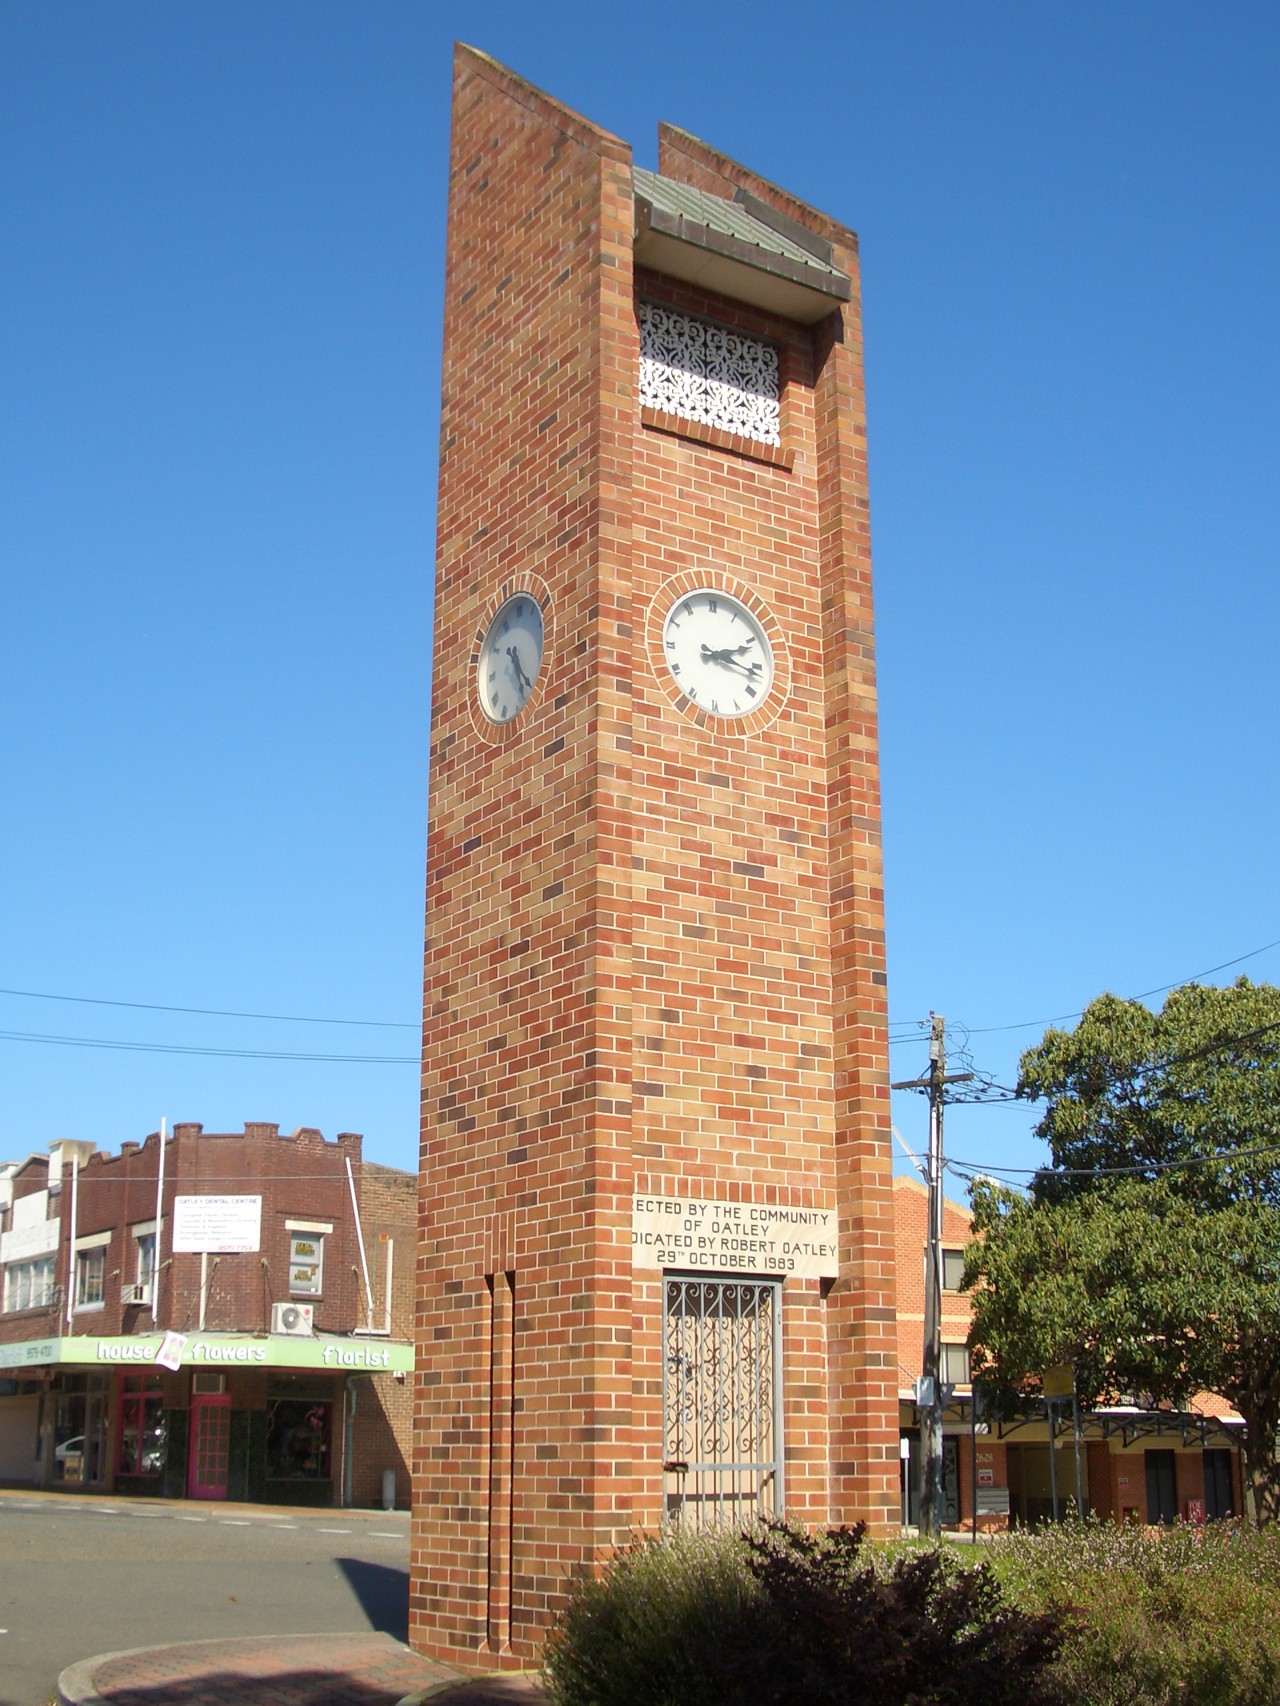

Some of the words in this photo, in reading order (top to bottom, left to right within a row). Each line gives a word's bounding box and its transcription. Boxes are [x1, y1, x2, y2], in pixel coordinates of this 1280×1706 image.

[689, 1203, 708, 1217] BY
[713, 1206, 742, 1219] THE
[750, 1208, 829, 1226] COMMUNITY
[684, 1219, 703, 1232] OF
[711, 1221, 769, 1237] OATLEY
[698, 1236, 716, 1250] BY
[721, 1238, 776, 1253] ROBERT
[783, 1242, 837, 1257] OATLEY
[689, 1252, 757, 1268] OCTOBER
[764, 1256, 795, 1270] 1983
[97, 1340, 154, 1360] house
[191, 1342, 266, 1361] flowers
[323, 1346, 391, 1367] florist
